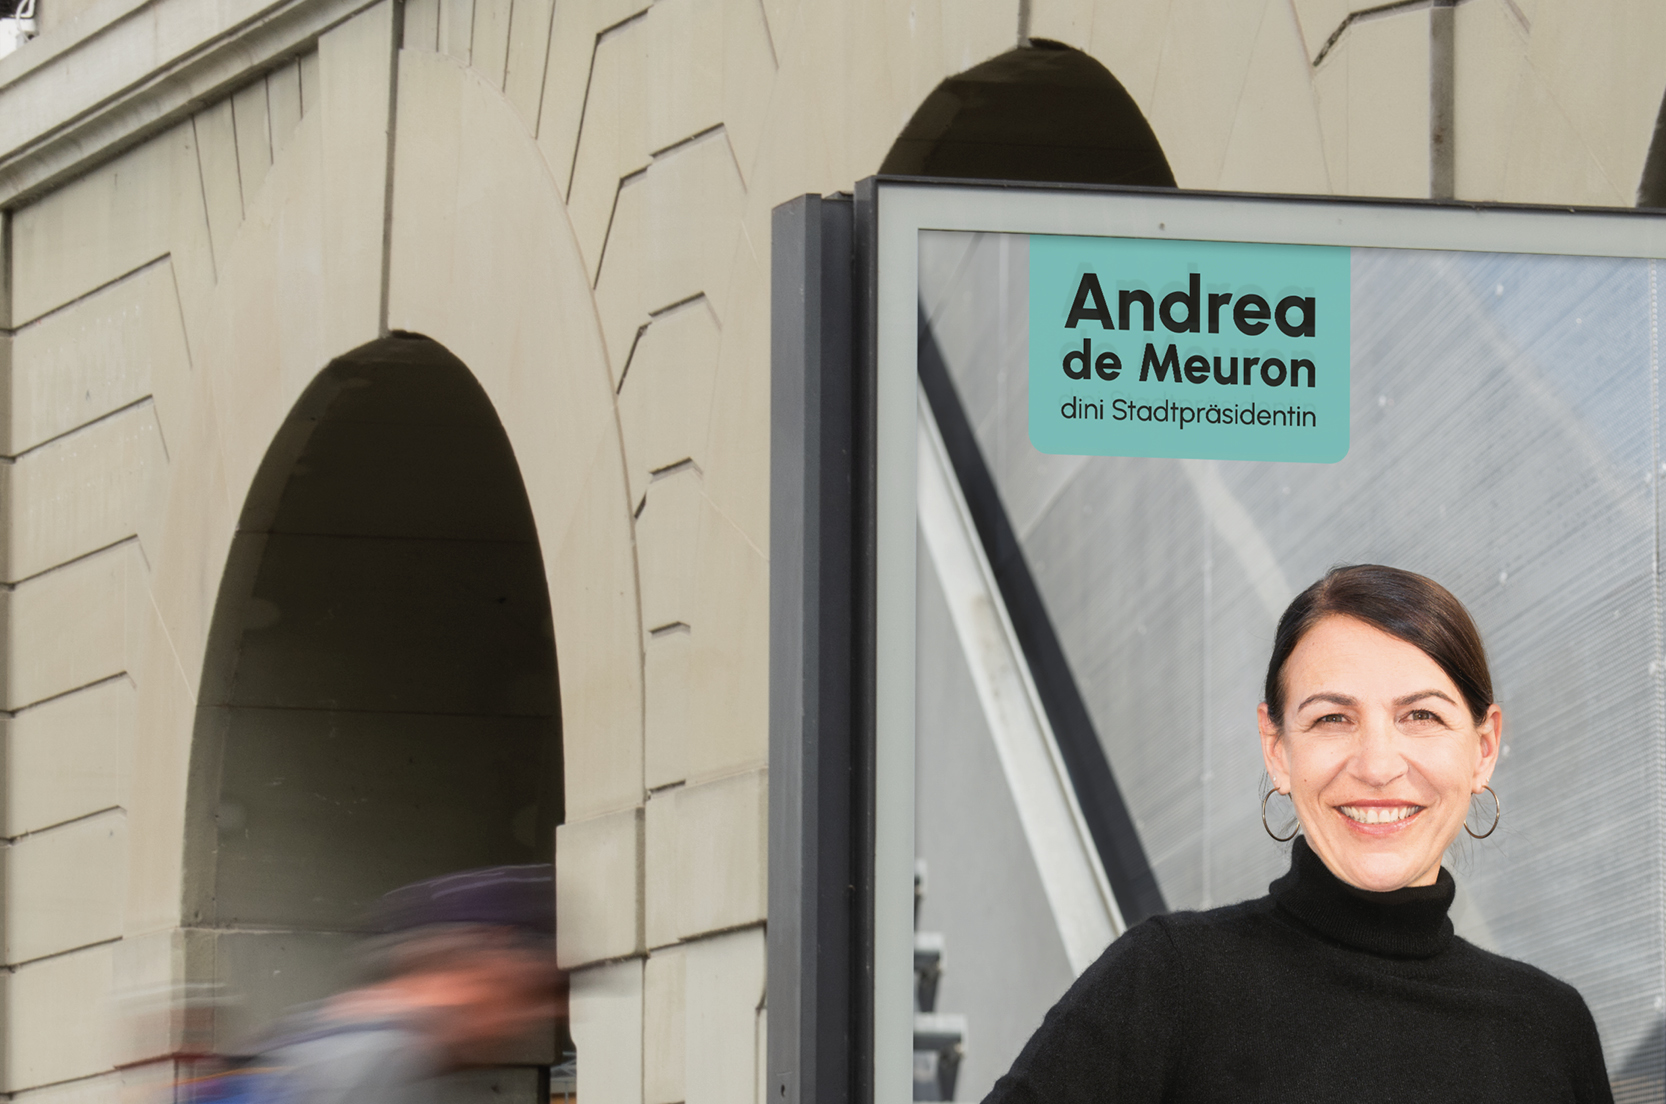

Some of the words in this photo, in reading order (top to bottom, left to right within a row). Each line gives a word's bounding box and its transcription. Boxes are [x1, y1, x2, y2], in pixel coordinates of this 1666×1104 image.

[1065, 273, 1315, 337] Andrea
[1063, 338, 1122, 381] de
[1139, 343, 1315, 387] Meuron
[1061, 396, 1103, 419] dini
[1113, 399, 1316, 429] Stadtpräsidentin
